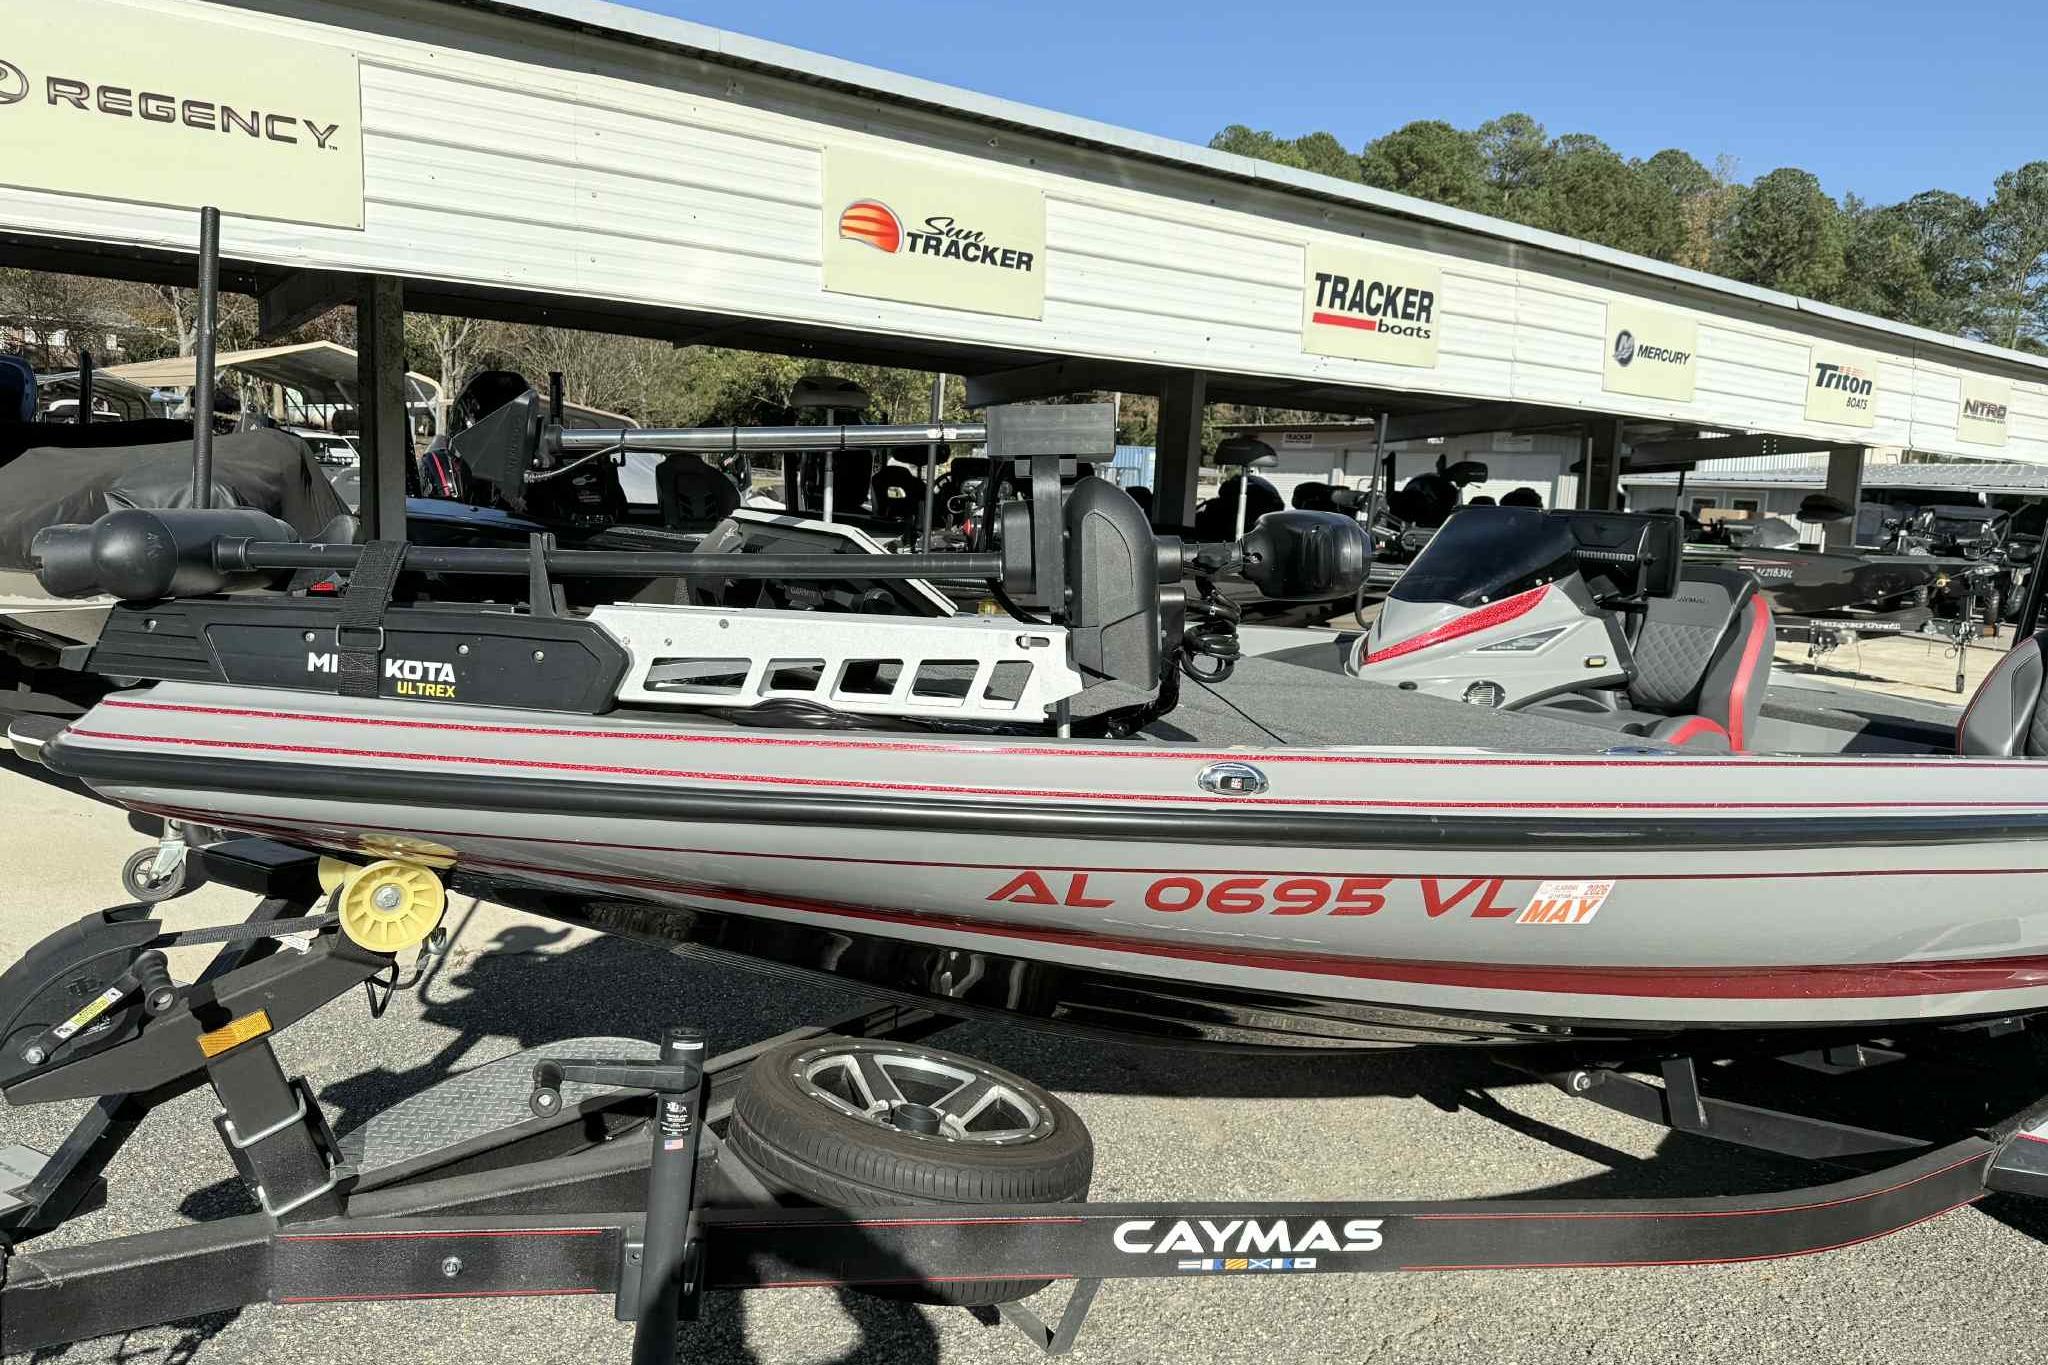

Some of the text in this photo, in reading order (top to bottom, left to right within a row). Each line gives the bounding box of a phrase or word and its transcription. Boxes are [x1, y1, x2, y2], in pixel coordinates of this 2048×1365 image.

[46, 75, 340, 149] REGENCY
[915, 216, 986, 243] Sun
[906, 231, 1034, 272] TRACKER
[1314, 272, 1434, 324] TRACKER
[1377, 318, 1431, 340] boats
[1637, 344, 1692, 366] MERCURY
[1815, 362, 1873, 396] Triton
[1846, 396, 1868, 410] BOATS
[1963, 398, 2008, 419] NITRO
[307, 651, 456, 683] MI KOTA
[397, 681, 455, 698] ULTREX
[985, 870, 1518, 918] AL 0695 VL
[1519, 899, 1601, 923] MAY
[1113, 1219, 1384, 1254] CAYMAS
